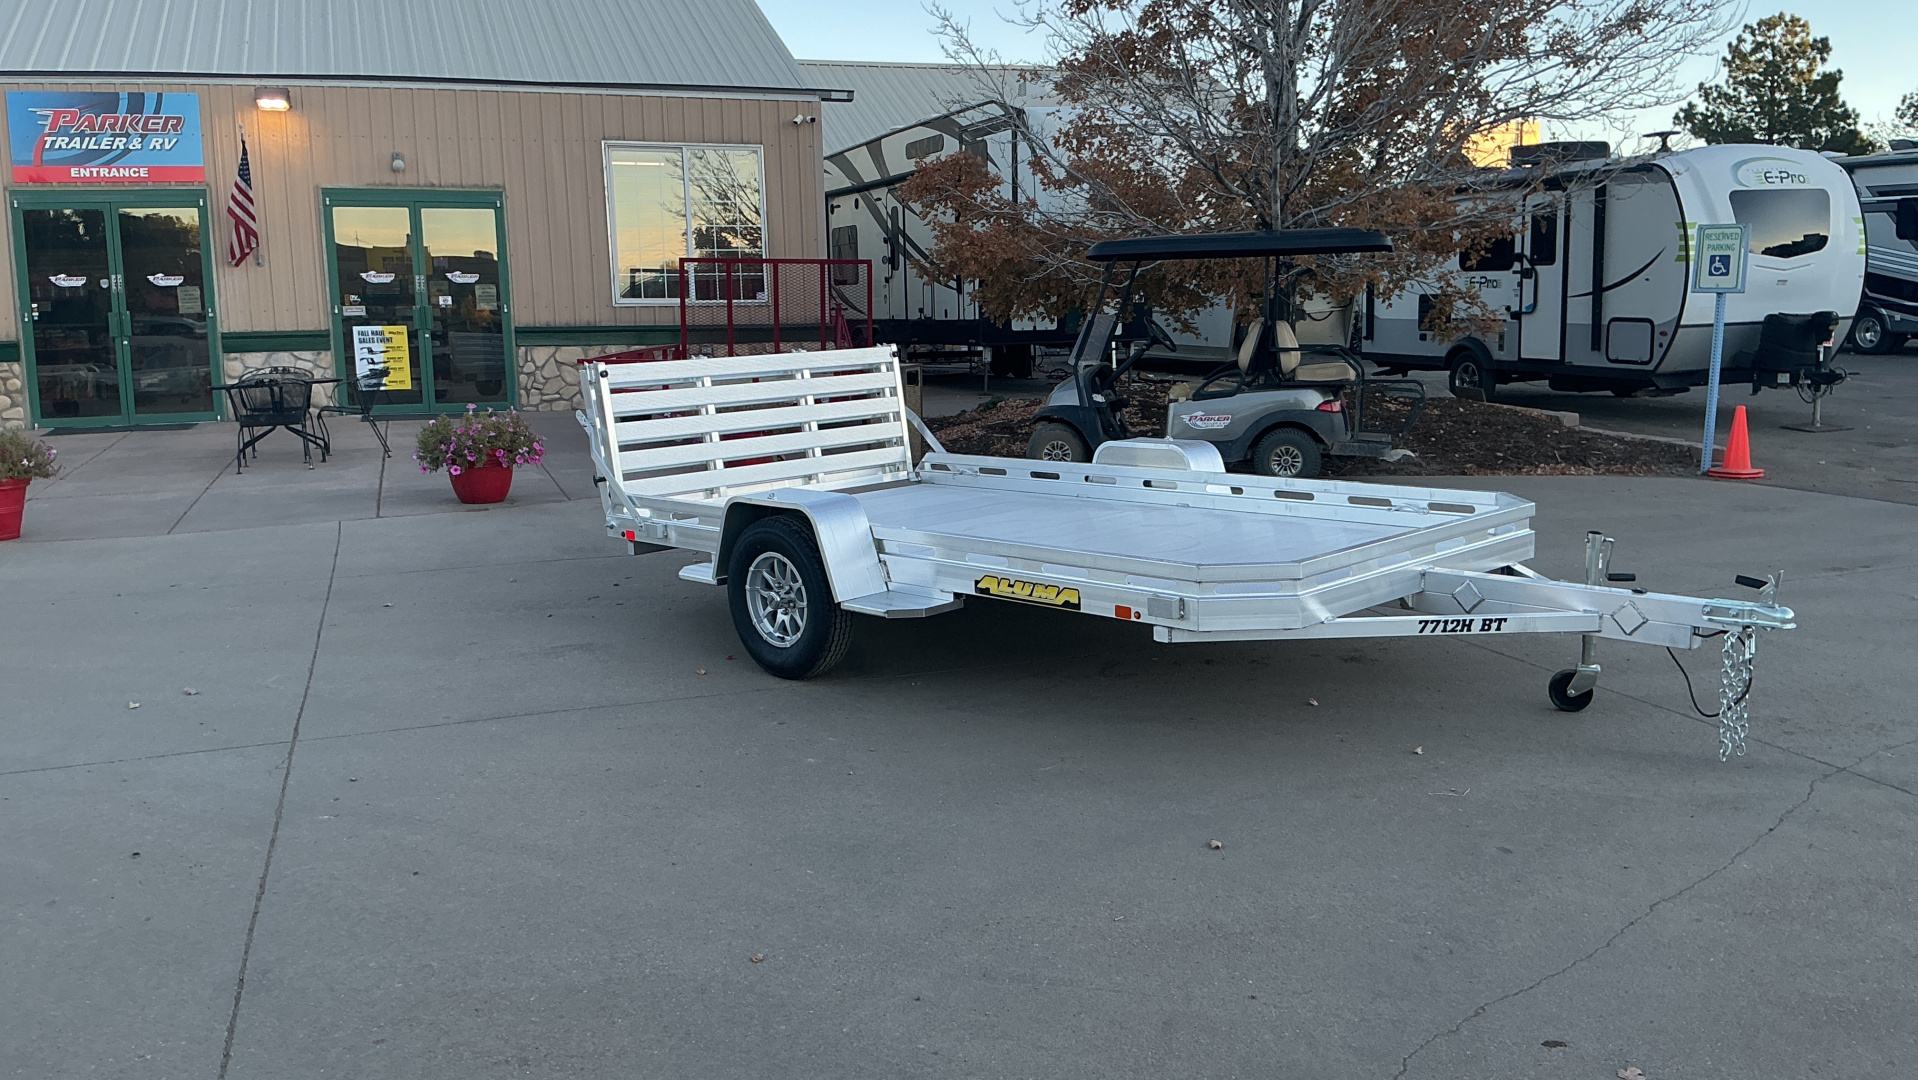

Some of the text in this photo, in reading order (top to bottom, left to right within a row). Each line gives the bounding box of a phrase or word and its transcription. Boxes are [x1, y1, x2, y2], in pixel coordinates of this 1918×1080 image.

[40, 108, 185, 134] PARKER
[44, 136, 178, 150] TRAILER & RV
[70, 167, 149, 178] ENTRANCE
[1763, 170, 1806, 184] E-Pro
[1705, 232, 1740, 241] RESERVED
[1707, 243, 1736, 251] PARKING
[371, 329, 385, 337] HAUL
[376, 336, 393, 344] EVENT
[976, 574, 1080, 607] ALUMA
[1418, 618, 1508, 634] 7712H BT
